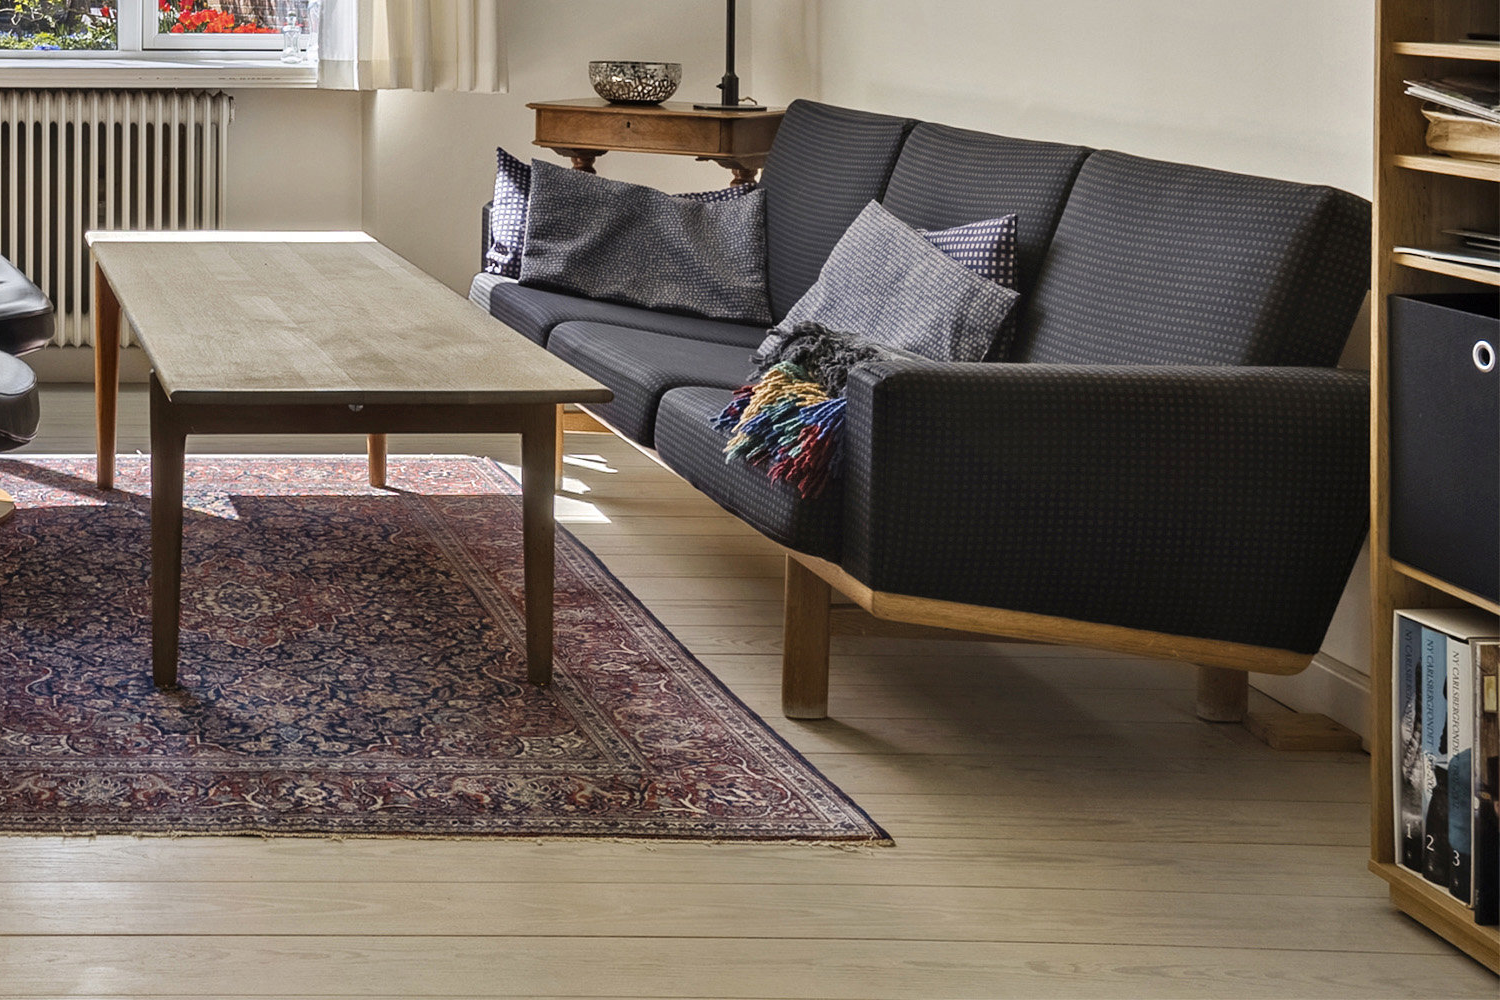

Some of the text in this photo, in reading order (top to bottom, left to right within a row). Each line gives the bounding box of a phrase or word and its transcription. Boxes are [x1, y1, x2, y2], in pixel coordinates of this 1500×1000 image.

[1426, 638, 1435, 654] NY
[1451, 650, 1461, 666] NY
[1425, 656, 1435, 745] CARLSBERGFONDET
[1451, 667, 1461, 760] CARLSBERGFONDET
[1406, 823, 1414, 839] 1
[1426, 834, 1435, 852] 2
[1452, 850, 1461, 867] 3
